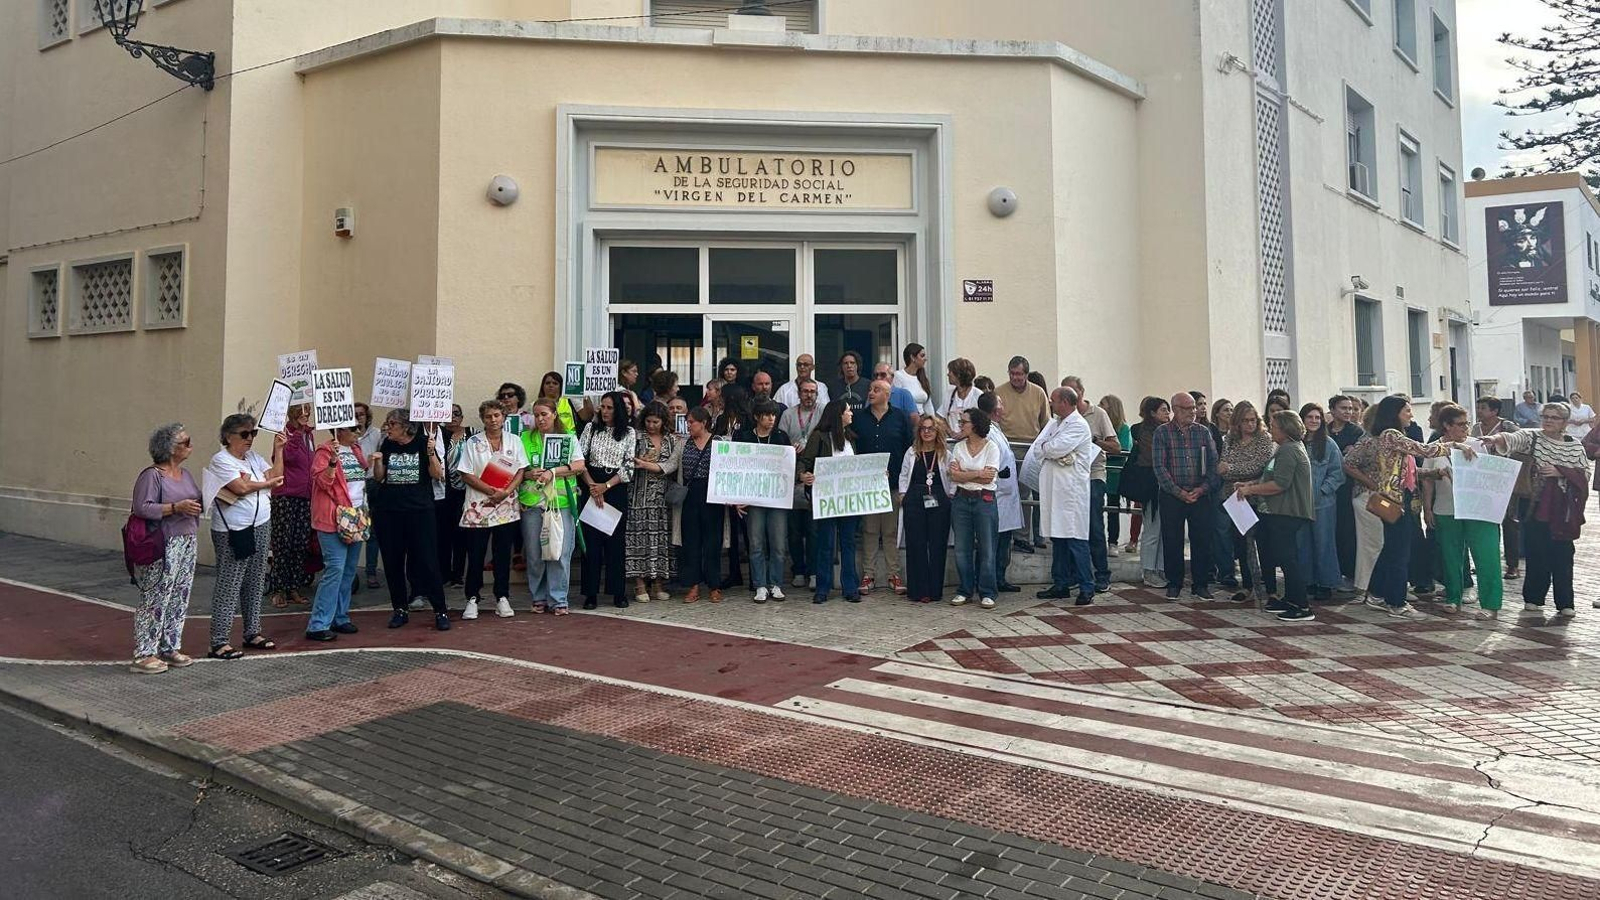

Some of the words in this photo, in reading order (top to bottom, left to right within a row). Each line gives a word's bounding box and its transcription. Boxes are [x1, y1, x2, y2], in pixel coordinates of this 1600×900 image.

[653, 156, 855, 176] AMBULATORIO
[673, 176, 689, 187] DE
[694, 177, 711, 188] LA
[716, 177, 789, 189] SEGURIDAD
[794, 179, 844, 190] SOCIAL
[654, 190, 723, 201] "VIRGEN
[737, 192, 767, 203] DEL
[780, 193, 852, 204] CARMEN"
[586, 350, 596, 363] LA
[597, 350, 618, 364] SALUD
[377, 368, 408, 379] SANIDAD
[568, 368, 580, 383] NO
[592, 366, 600, 375] ES
[602, 366, 611, 375] UN
[314, 373, 325, 389] LA
[326, 371, 351, 388] SALUD
[414, 376, 452, 387] SANIDAD
[586, 377, 616, 391] DERECHO
[323, 392, 333, 403] ES
[334, 391, 345, 402] UN
[418, 400, 430, 408] NO
[316, 404, 354, 424] DERECHO
[547, 442, 561, 460] NO
[717, 442, 730, 454] NO
[714, 471, 788, 499] PERMANENTES
[819, 489, 890, 516] PACIENTES
